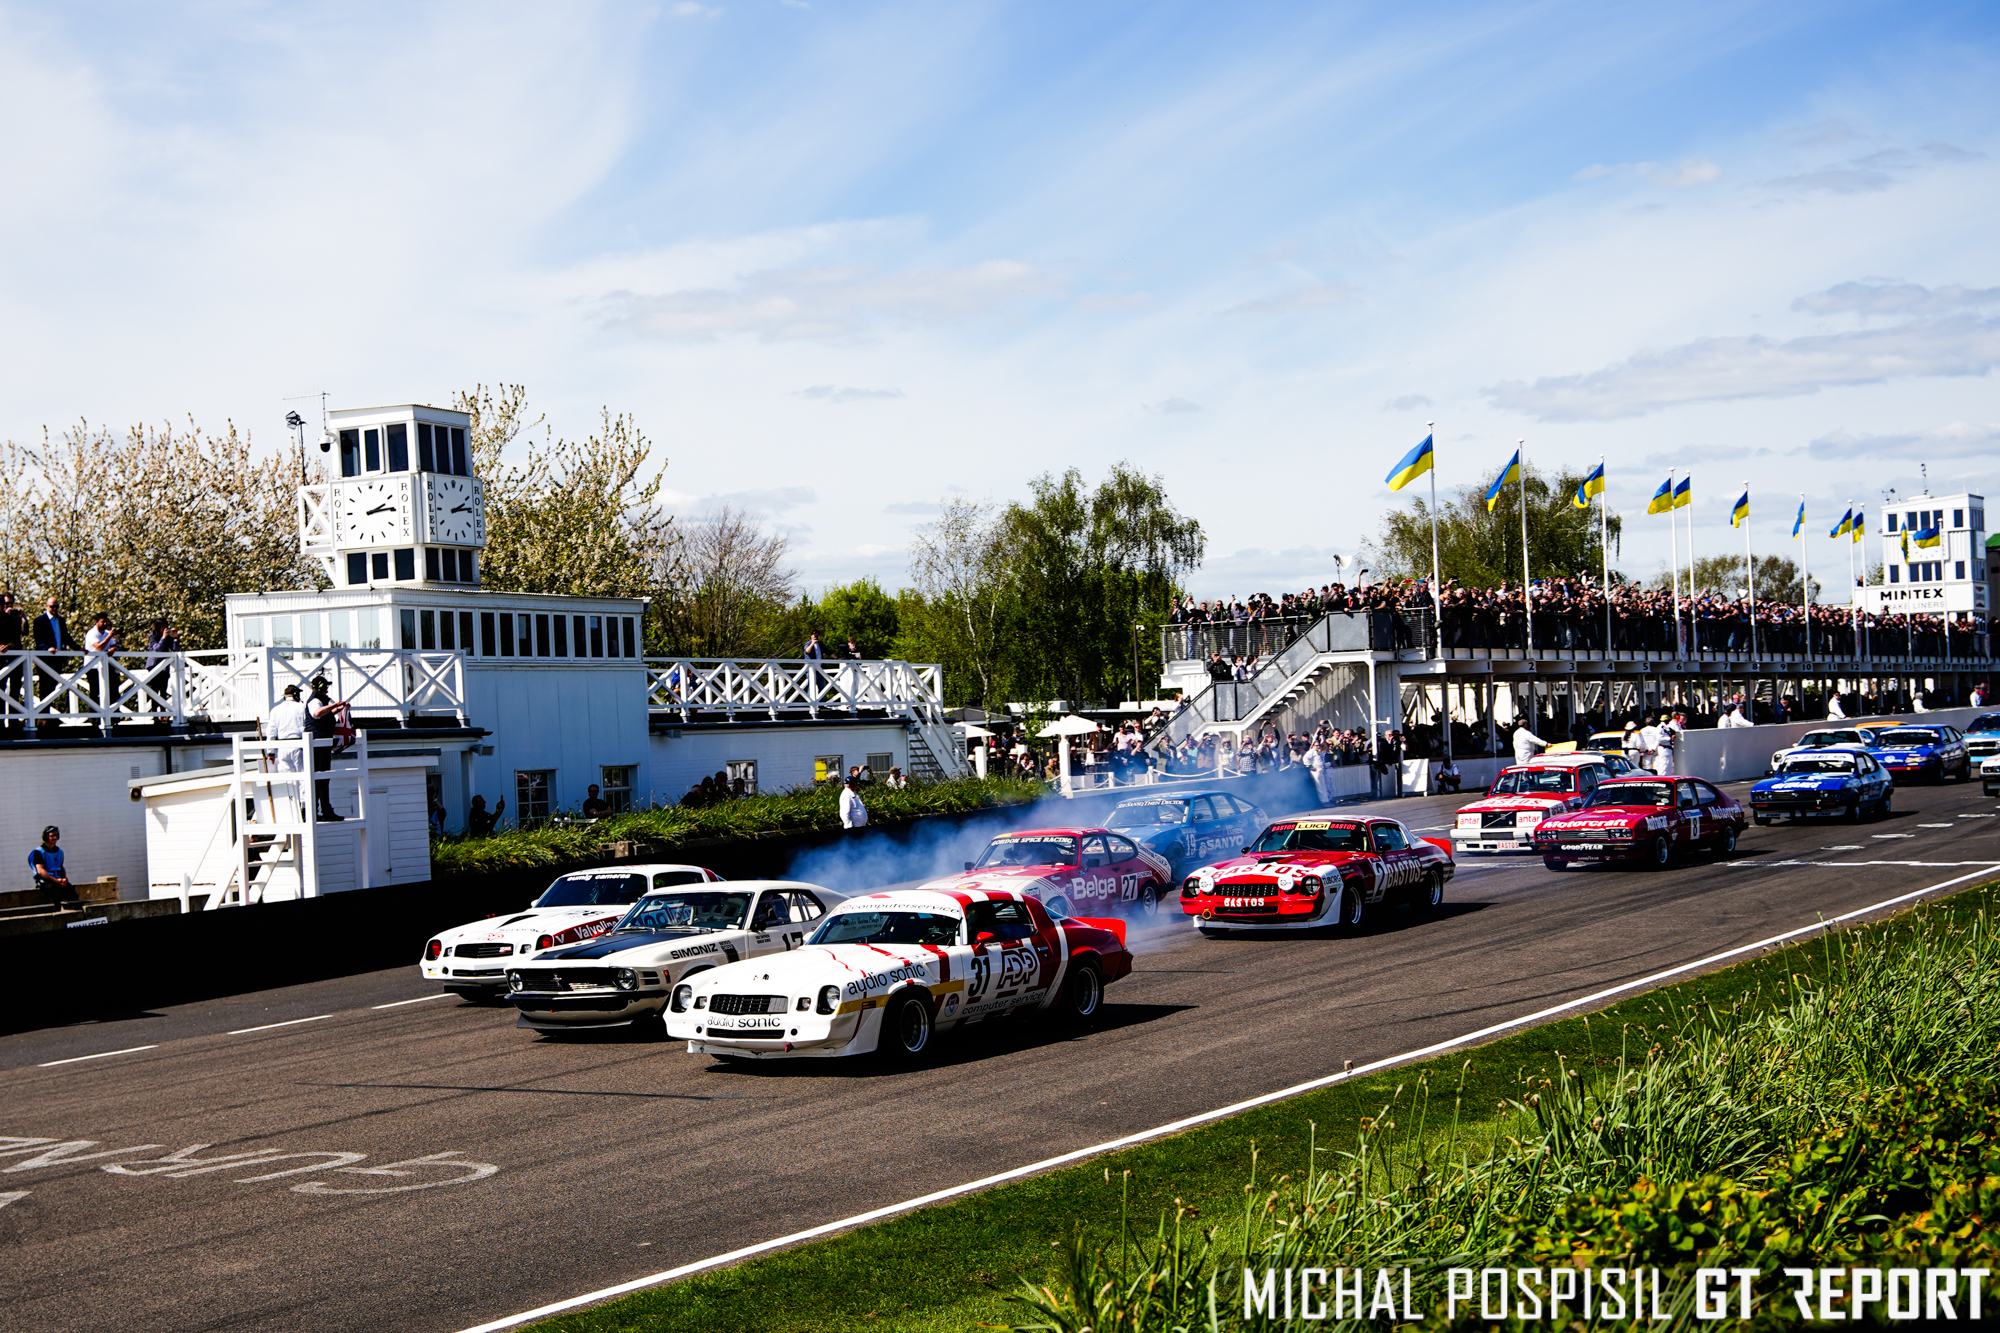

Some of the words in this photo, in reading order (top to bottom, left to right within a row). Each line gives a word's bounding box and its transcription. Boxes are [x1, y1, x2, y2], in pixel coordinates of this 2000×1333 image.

[401, 483, 410, 536] ROLEX
[428, 481, 436, 535] ROLEX
[474, 486, 483, 539] ROLEX
[334, 489, 343, 542] ROLEX
[1880, 588, 1944, 601] MINTEX
[1913, 601, 1945, 609] LINERS
[1486, 662, 1491, 671] 1
[1528, 662, 1535, 671] 2
[1569, 662, 1575, 671] 3
[1607, 662, 1613, 671] 4
[1643, 662, 1649, 671] 5
[1676, 662, 1682, 671] 6
[1723, 662, 1728, 671] 7
[1752, 663, 1758, 671] 8
[1780, 663, 1786, 671] 9
[1802, 663, 1811, 671] 10
[1828, 663, 1836, 671] 11
[1851, 663, 1859, 671] 12
[1883, 663, 1892, 671] 14
[1904, 663, 1913, 671] 15
[1460, 816, 1480, 826] antar
[1518, 814, 1541, 824] antar
[1542, 818, 1629, 829] Motorcraft
[1271, 823, 1296, 832] BASTOS
[1692, 817, 1698, 837] 8
[1043, 836, 1073, 844] RACING
[1206, 835, 1244, 850] SANYO
[1497, 841, 1520, 849] BASTOS
[1561, 843, 1604, 851] GOODYEAR
[1211, 863, 1310, 879] BASTOS
[1386, 859, 1422, 889] BASTOS
[1322, 873, 1342, 886] TUBORG
[1375, 862, 1385, 895] 2
[1071, 874, 1117, 900] Belga
[1122, 874, 1137, 901] 27
[1223, 897, 1265, 908] BASTOS
[781, 931, 803, 951] 17
[670, 943, 719, 959] SIMONIZ
[995, 947, 1039, 990] ADP
[847, 971, 888, 995] audio
[889, 963, 926, 983] sonic
[968, 956, 991, 997] 31
[962, 999, 1007, 1015] computer
[1009, 991, 1044, 1006] service
[707, 1015, 735, 1028] audio
[737, 1015, 781, 1028] sonic
